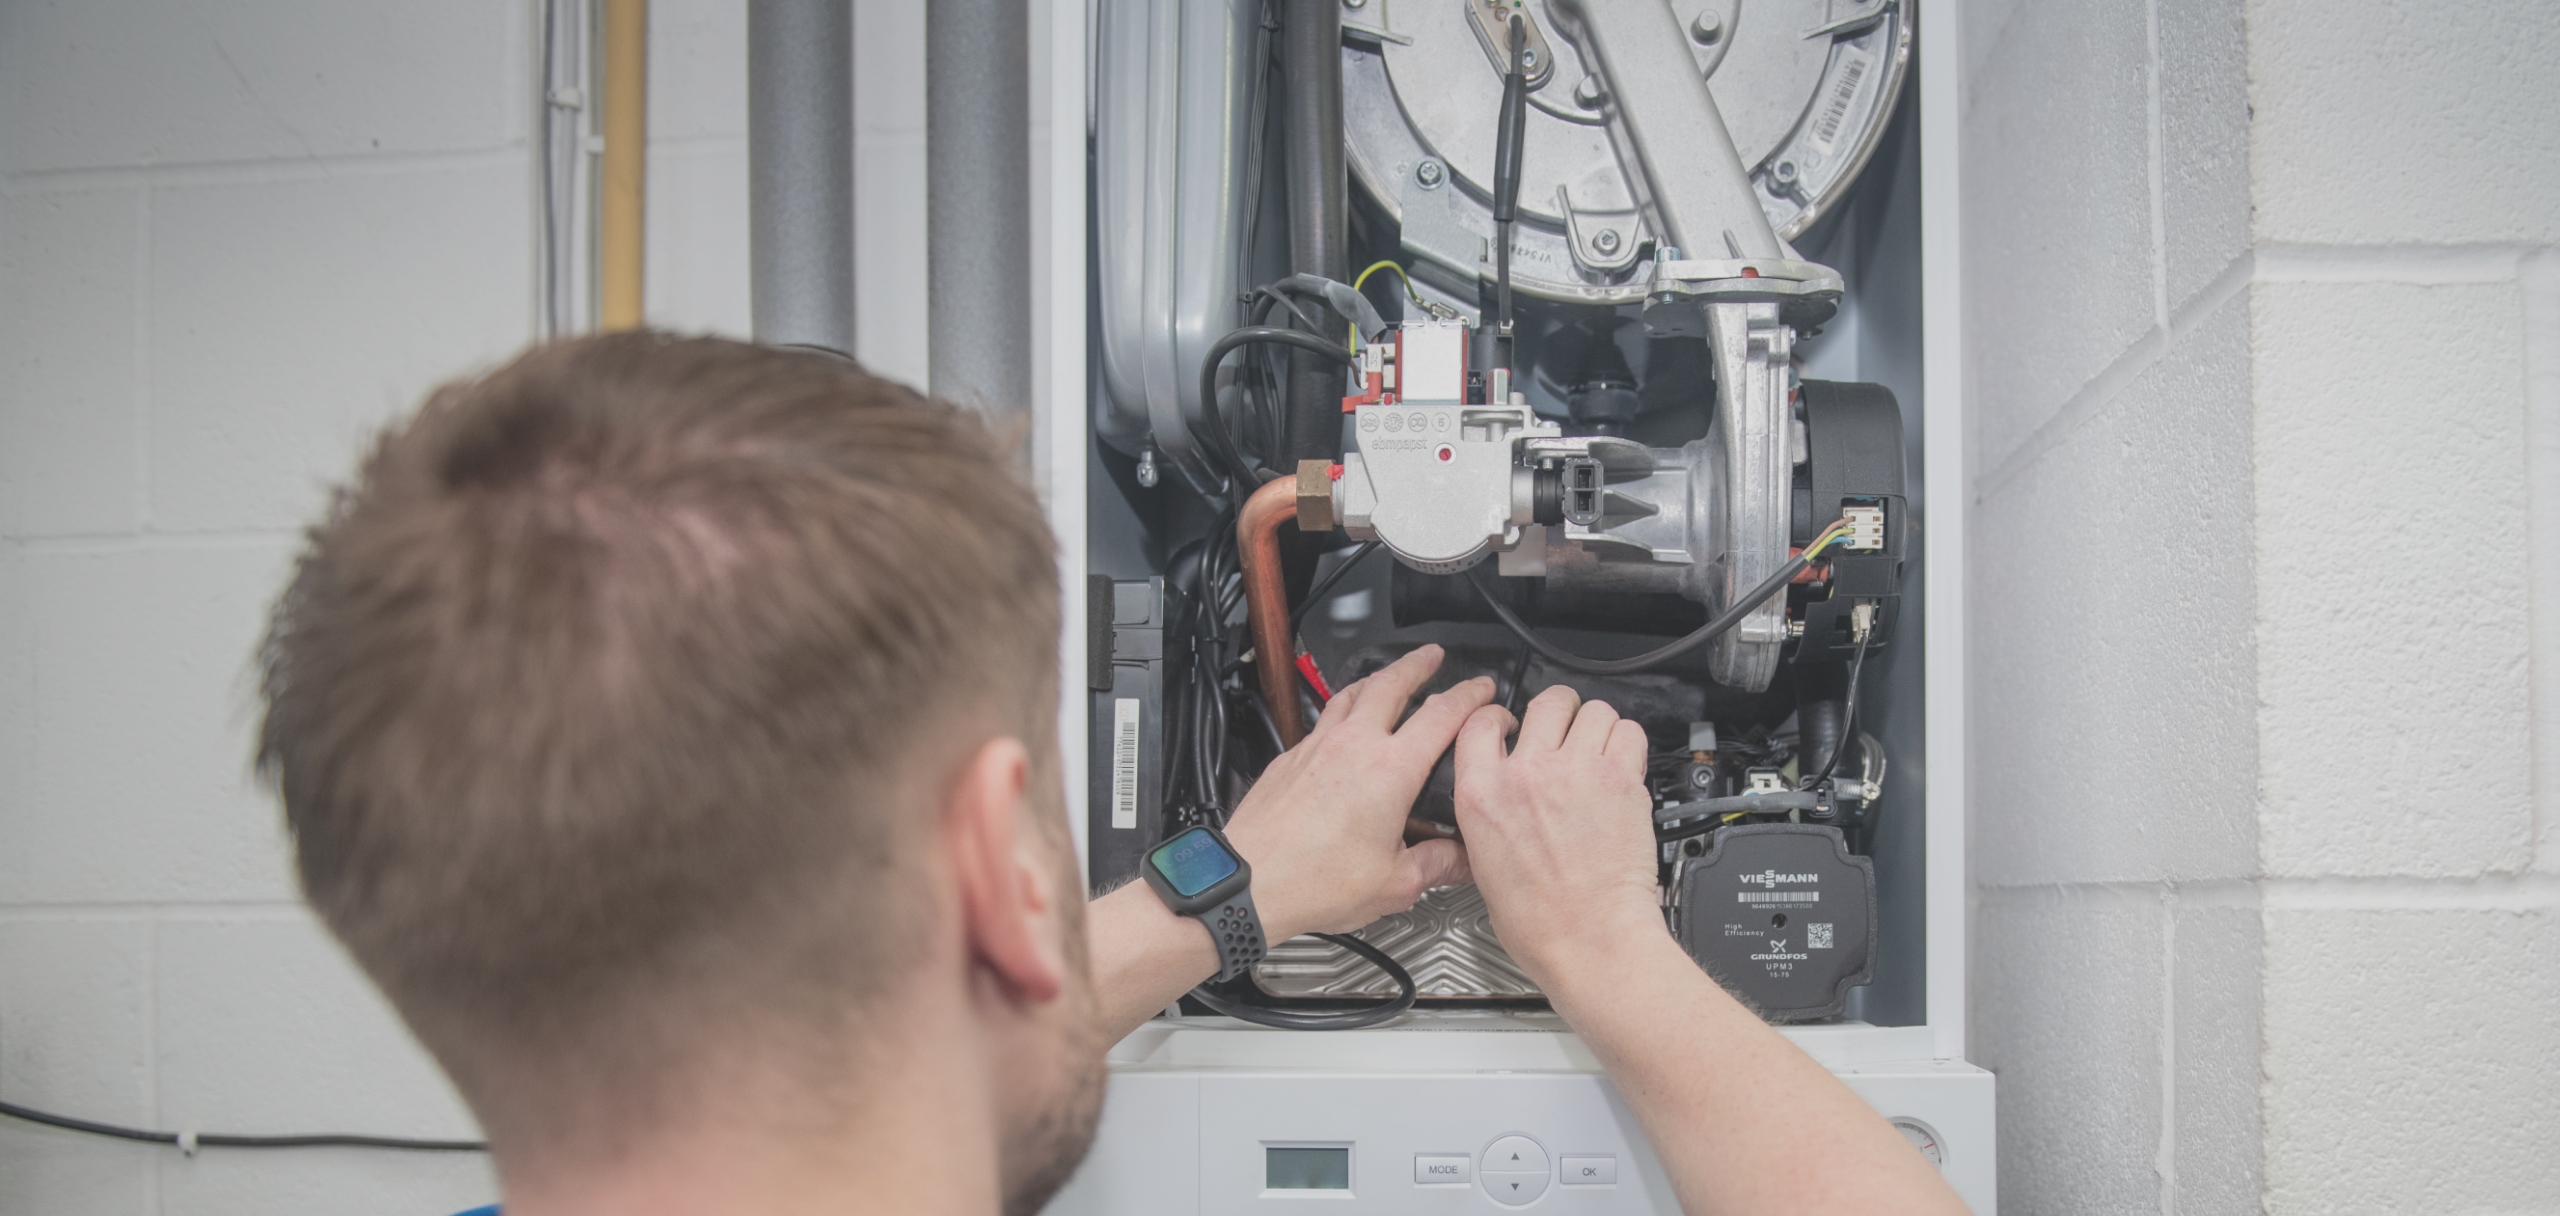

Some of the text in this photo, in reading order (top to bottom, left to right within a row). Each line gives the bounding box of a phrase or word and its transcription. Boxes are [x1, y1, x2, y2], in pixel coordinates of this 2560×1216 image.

[1371, 436, 1427, 452] ebmpapst
[1739, 869, 1818, 888] VIESSMANN
[1766, 963, 1793, 971] UPM3
[1428, 1165, 1458, 1174] MODE
[1582, 1167, 1597, 1177] OK
